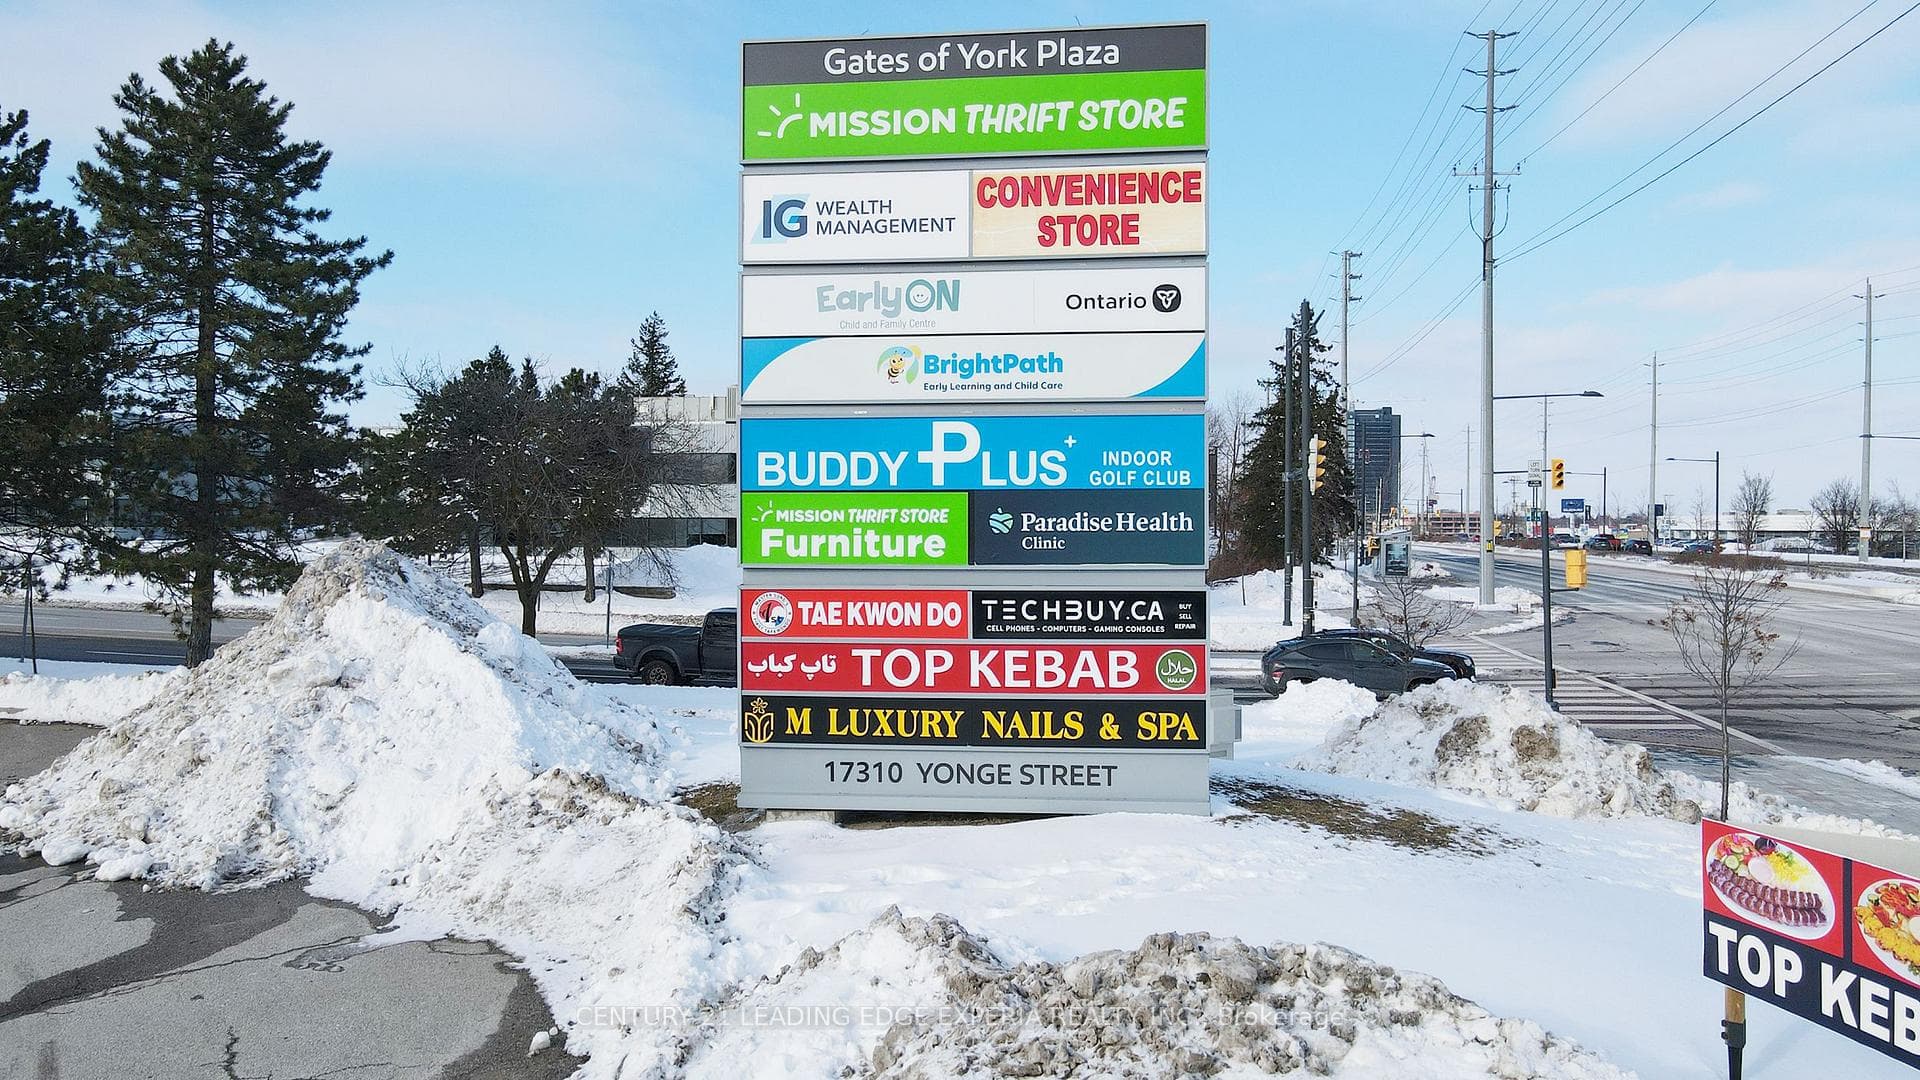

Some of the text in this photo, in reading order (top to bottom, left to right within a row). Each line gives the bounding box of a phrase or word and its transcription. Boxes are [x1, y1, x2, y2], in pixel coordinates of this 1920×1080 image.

[825, 38, 1119, 75] Gates of York Plaza
[810, 97, 1187, 137] MISSION THRIFT STORE
[977, 171, 1201, 208] CONVENIENCE
[763, 200, 807, 238] IG
[816, 200, 891, 215] WEALTH
[817, 218, 955, 234] MANAGEMENT
[1038, 214, 1139, 247] STORE
[1066, 293, 1146, 309] Ontario
[840, 319, 935, 330] Child and Family Centre
[924, 352, 1063, 379] BrightPath
[924, 383, 947, 392] Early
[950, 383, 991, 391] Learning
[758, 452, 908, 486] BUDDY
[1103, 451, 1172, 466] INDOOR
[1090, 470, 1190, 485] GOLF CLUB
[777, 509, 949, 523] MISSION THRIFT STORE
[1021, 512, 1193, 531] Paradise Health
[762, 528, 945, 557] Furniture
[1022, 537, 1065, 549] Clinic
[798, 602, 961, 626] TAE KWON DO
[982, 600, 1163, 620] TECHBUY.CA
[801, 654, 836, 680] تاپ
[852, 649, 1139, 688] TOP KEBAB
[785, 708, 1198, 740] M LUXURY NAILS & SPA
[825, 761, 1117, 786] 17310 YONGE STREET
[1708, 920, 1802, 998] TOP
